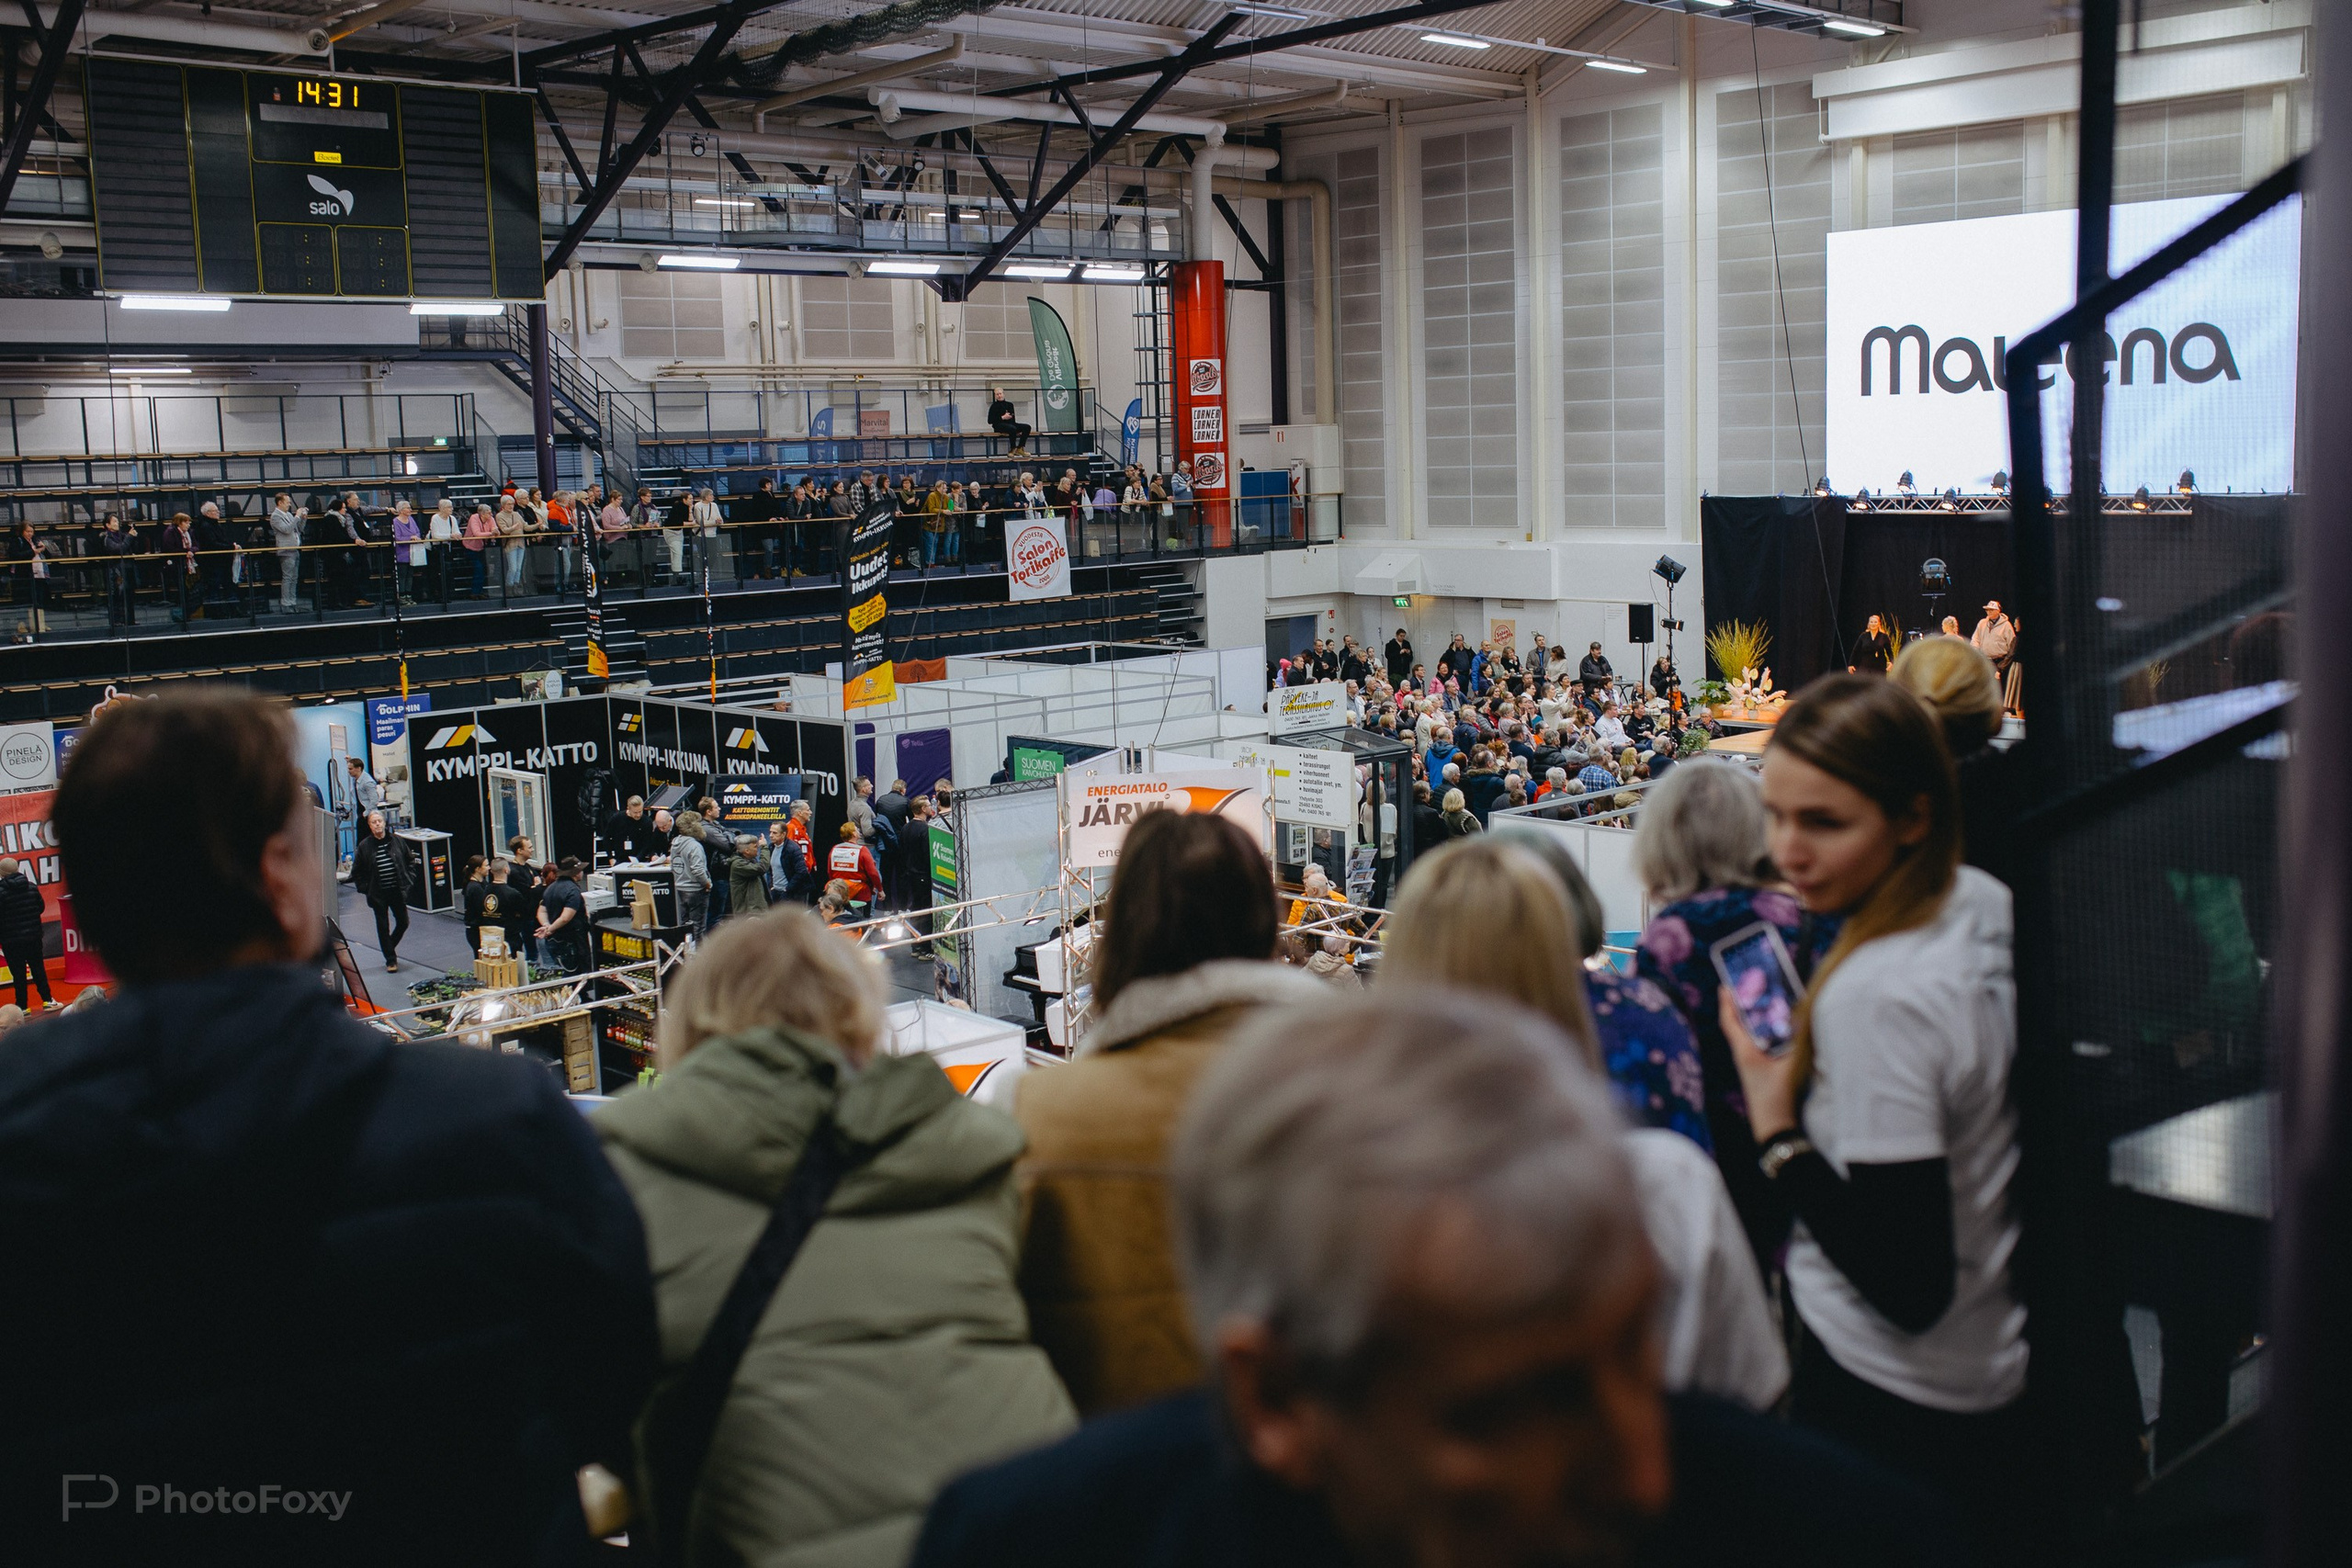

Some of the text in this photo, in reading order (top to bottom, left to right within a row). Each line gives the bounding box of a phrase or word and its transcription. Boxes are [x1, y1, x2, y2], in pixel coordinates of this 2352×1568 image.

[310, 200, 340, 215] salo
[1193, 410, 1220, 420] CORNER
[1017, 540, 1054, 565] Salon
[850, 551, 888, 580] Uudet
[1011, 547, 1066, 584] Torikaffe
[379, 704, 421, 716] DOLPHIN
[377, 725, 393, 733] paras
[377, 730, 396, 739] pesuri
[6, 744, 42, 758] PINELÄ
[618, 741, 710, 774] KYMPPI-IKKUNA
[8, 755, 42, 766] DESIGN
[426, 740, 597, 783] KYMPPI-KATTO
[1021, 757, 1056, 772] SUOMEN
[1087, 782, 1168, 796] ENERGIATALO
[723, 795, 791, 804] KYMPPI-KATTO
